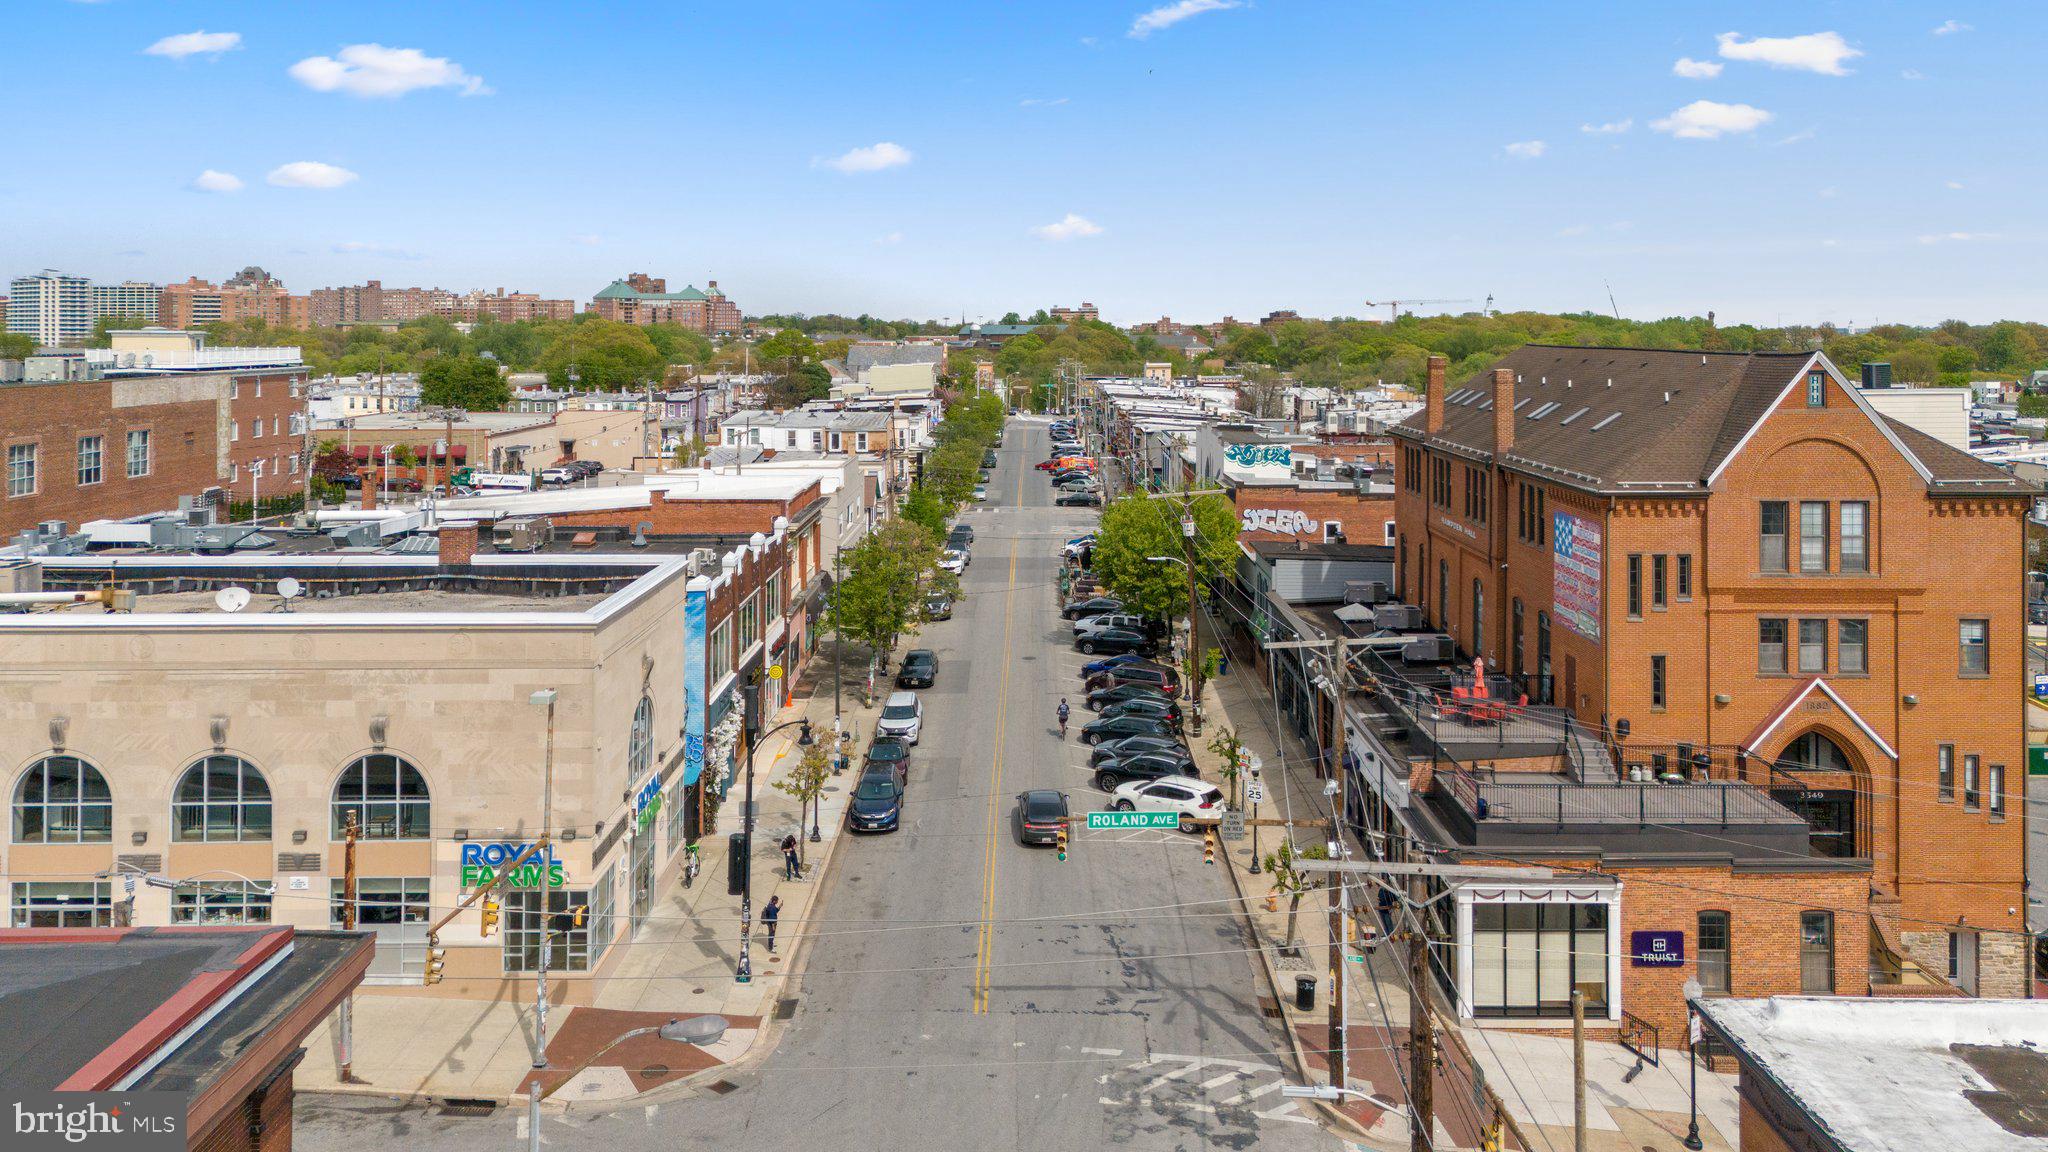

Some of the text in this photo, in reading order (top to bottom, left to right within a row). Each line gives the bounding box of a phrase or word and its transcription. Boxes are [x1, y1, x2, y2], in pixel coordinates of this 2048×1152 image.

[1248, 790, 1262, 799] 25
[1092, 815, 1176, 826] ROLAND AVE.
[461, 843, 563, 866] ROYAL
[461, 865, 564, 887] FARMS
[1642, 953, 1677, 962] TRUIST
